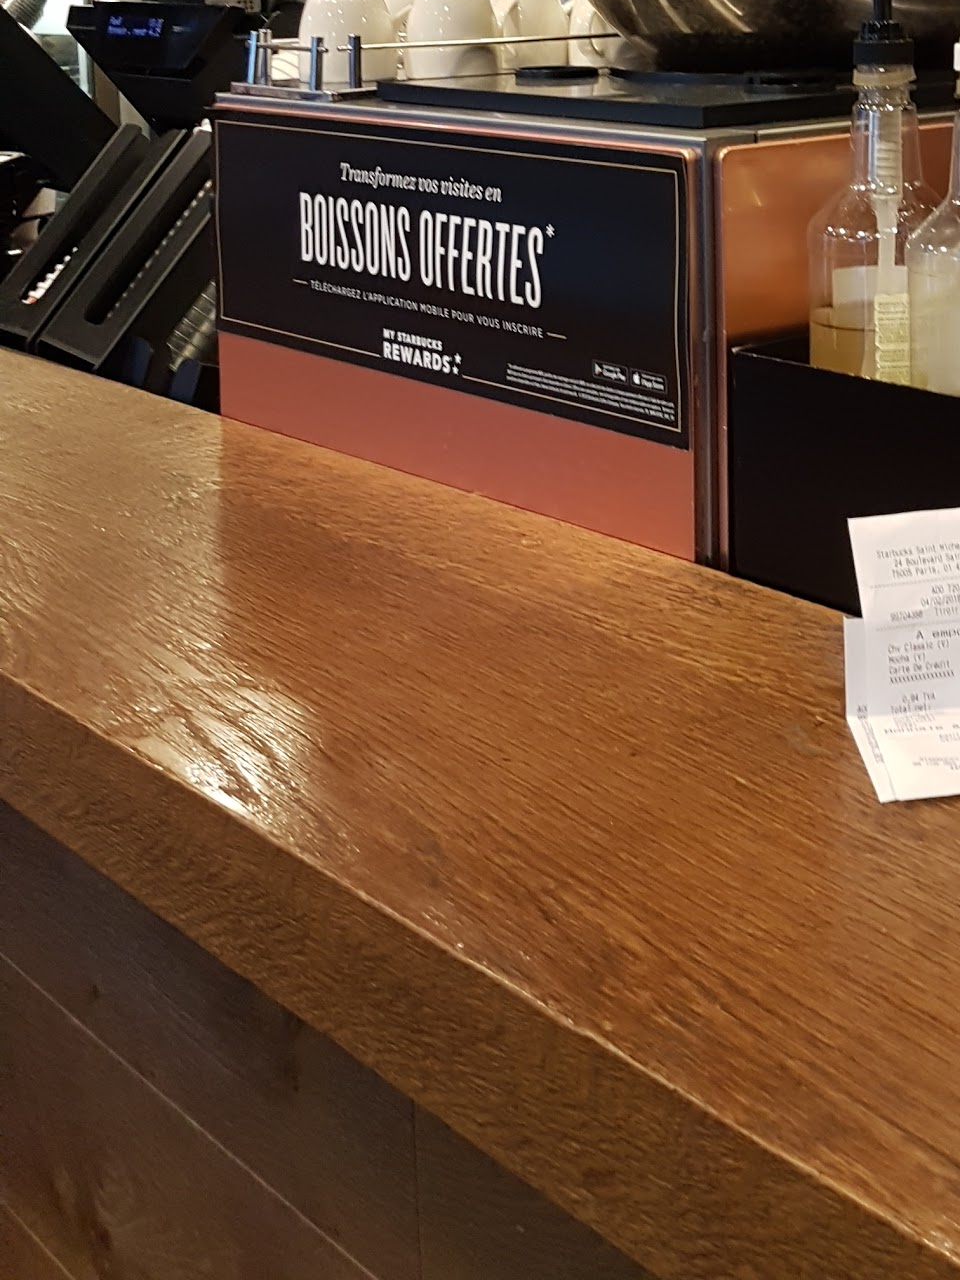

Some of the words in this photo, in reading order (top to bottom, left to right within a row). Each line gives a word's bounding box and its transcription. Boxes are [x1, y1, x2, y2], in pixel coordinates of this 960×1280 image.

[340, 161, 417, 190] Transformez
[418, 177, 439, 194] vos
[440, 176, 484, 200] visites
[484, 185, 503, 203] en
[299, 190, 412, 283] BOISSONS
[362, 290, 419, 313] L'APPLICATION
[419, 302, 450, 319] MOBILE
[451, 309, 475, 325] POUR
[476, 314, 501, 330] VOUS
[502, 319, 545, 339] INSCRIRE
[382, 327, 396, 341] MY
[397, 330, 443, 352] STARBUCKS
[382, 340, 451, 375] REWARDS
[876, 547, 913, 560] Starbucks
[916, 543, 937, 555] Saint
[905, 553, 943, 566] Boulevard
[915, 629, 925, 640] A
